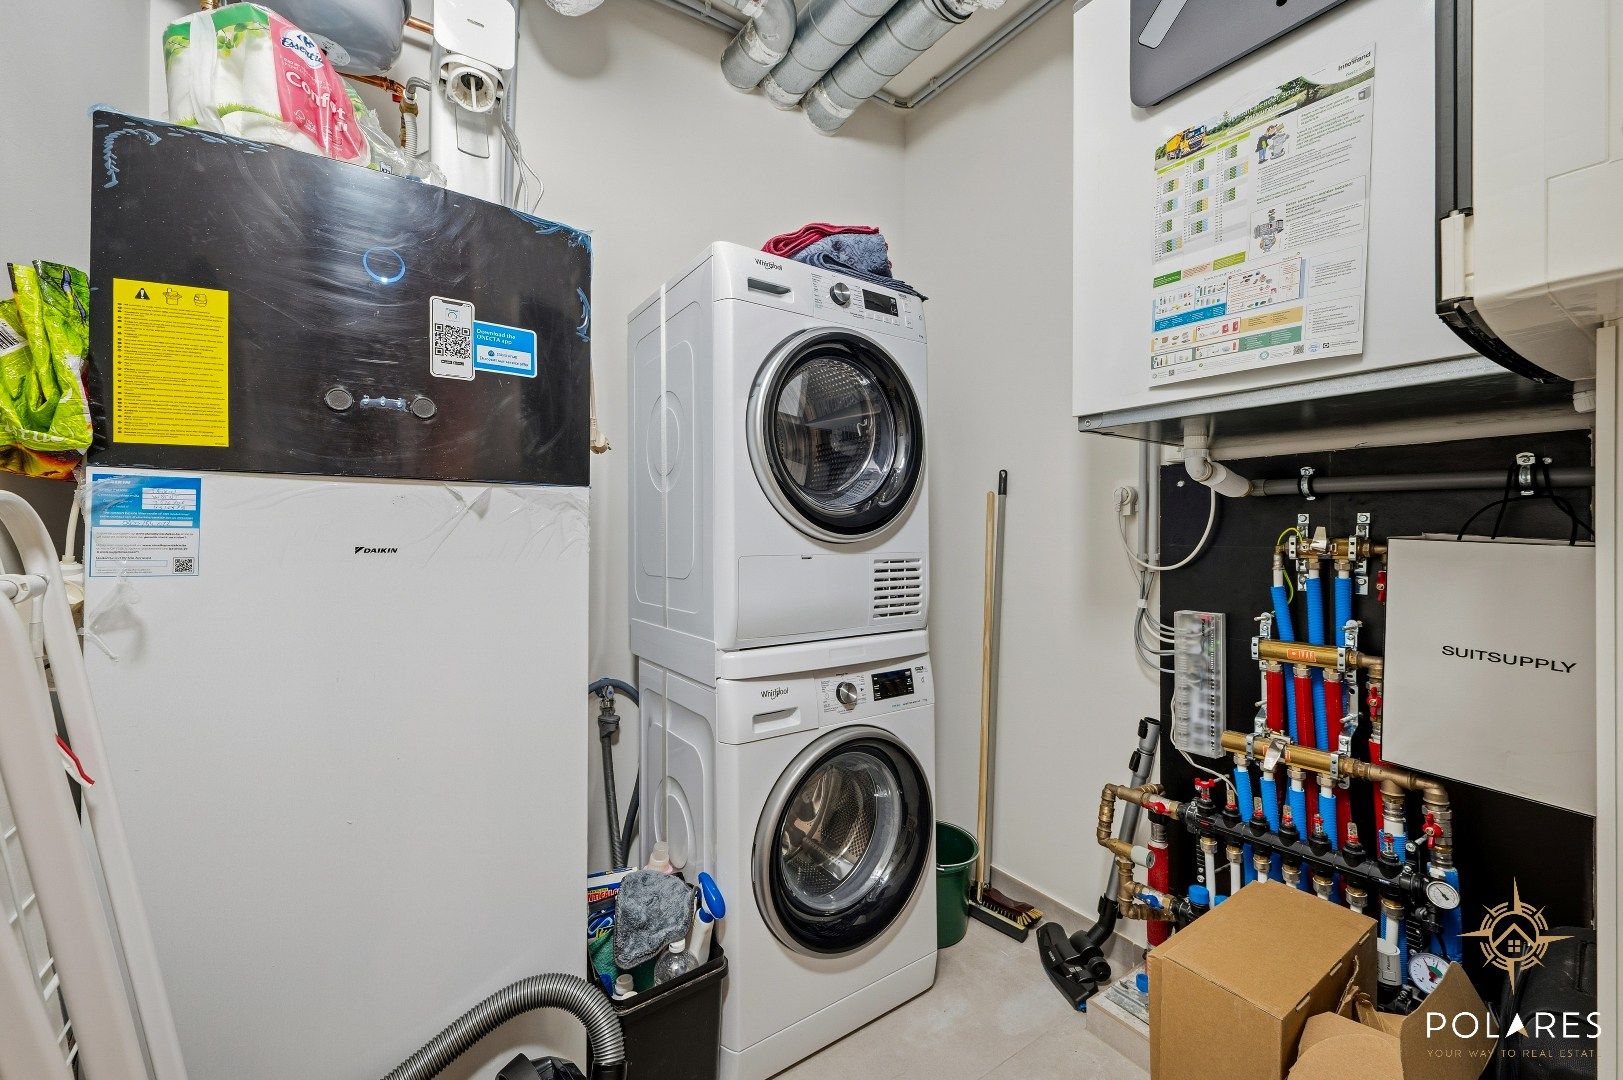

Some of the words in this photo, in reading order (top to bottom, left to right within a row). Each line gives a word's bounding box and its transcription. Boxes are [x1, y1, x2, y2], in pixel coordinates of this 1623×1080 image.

[754, 257, 783, 271] Whirlpool
[476, 328, 506, 338] Download
[1441, 645, 1577, 674] SUITSUPPLY
[760, 686, 789, 700] Whirlpool
